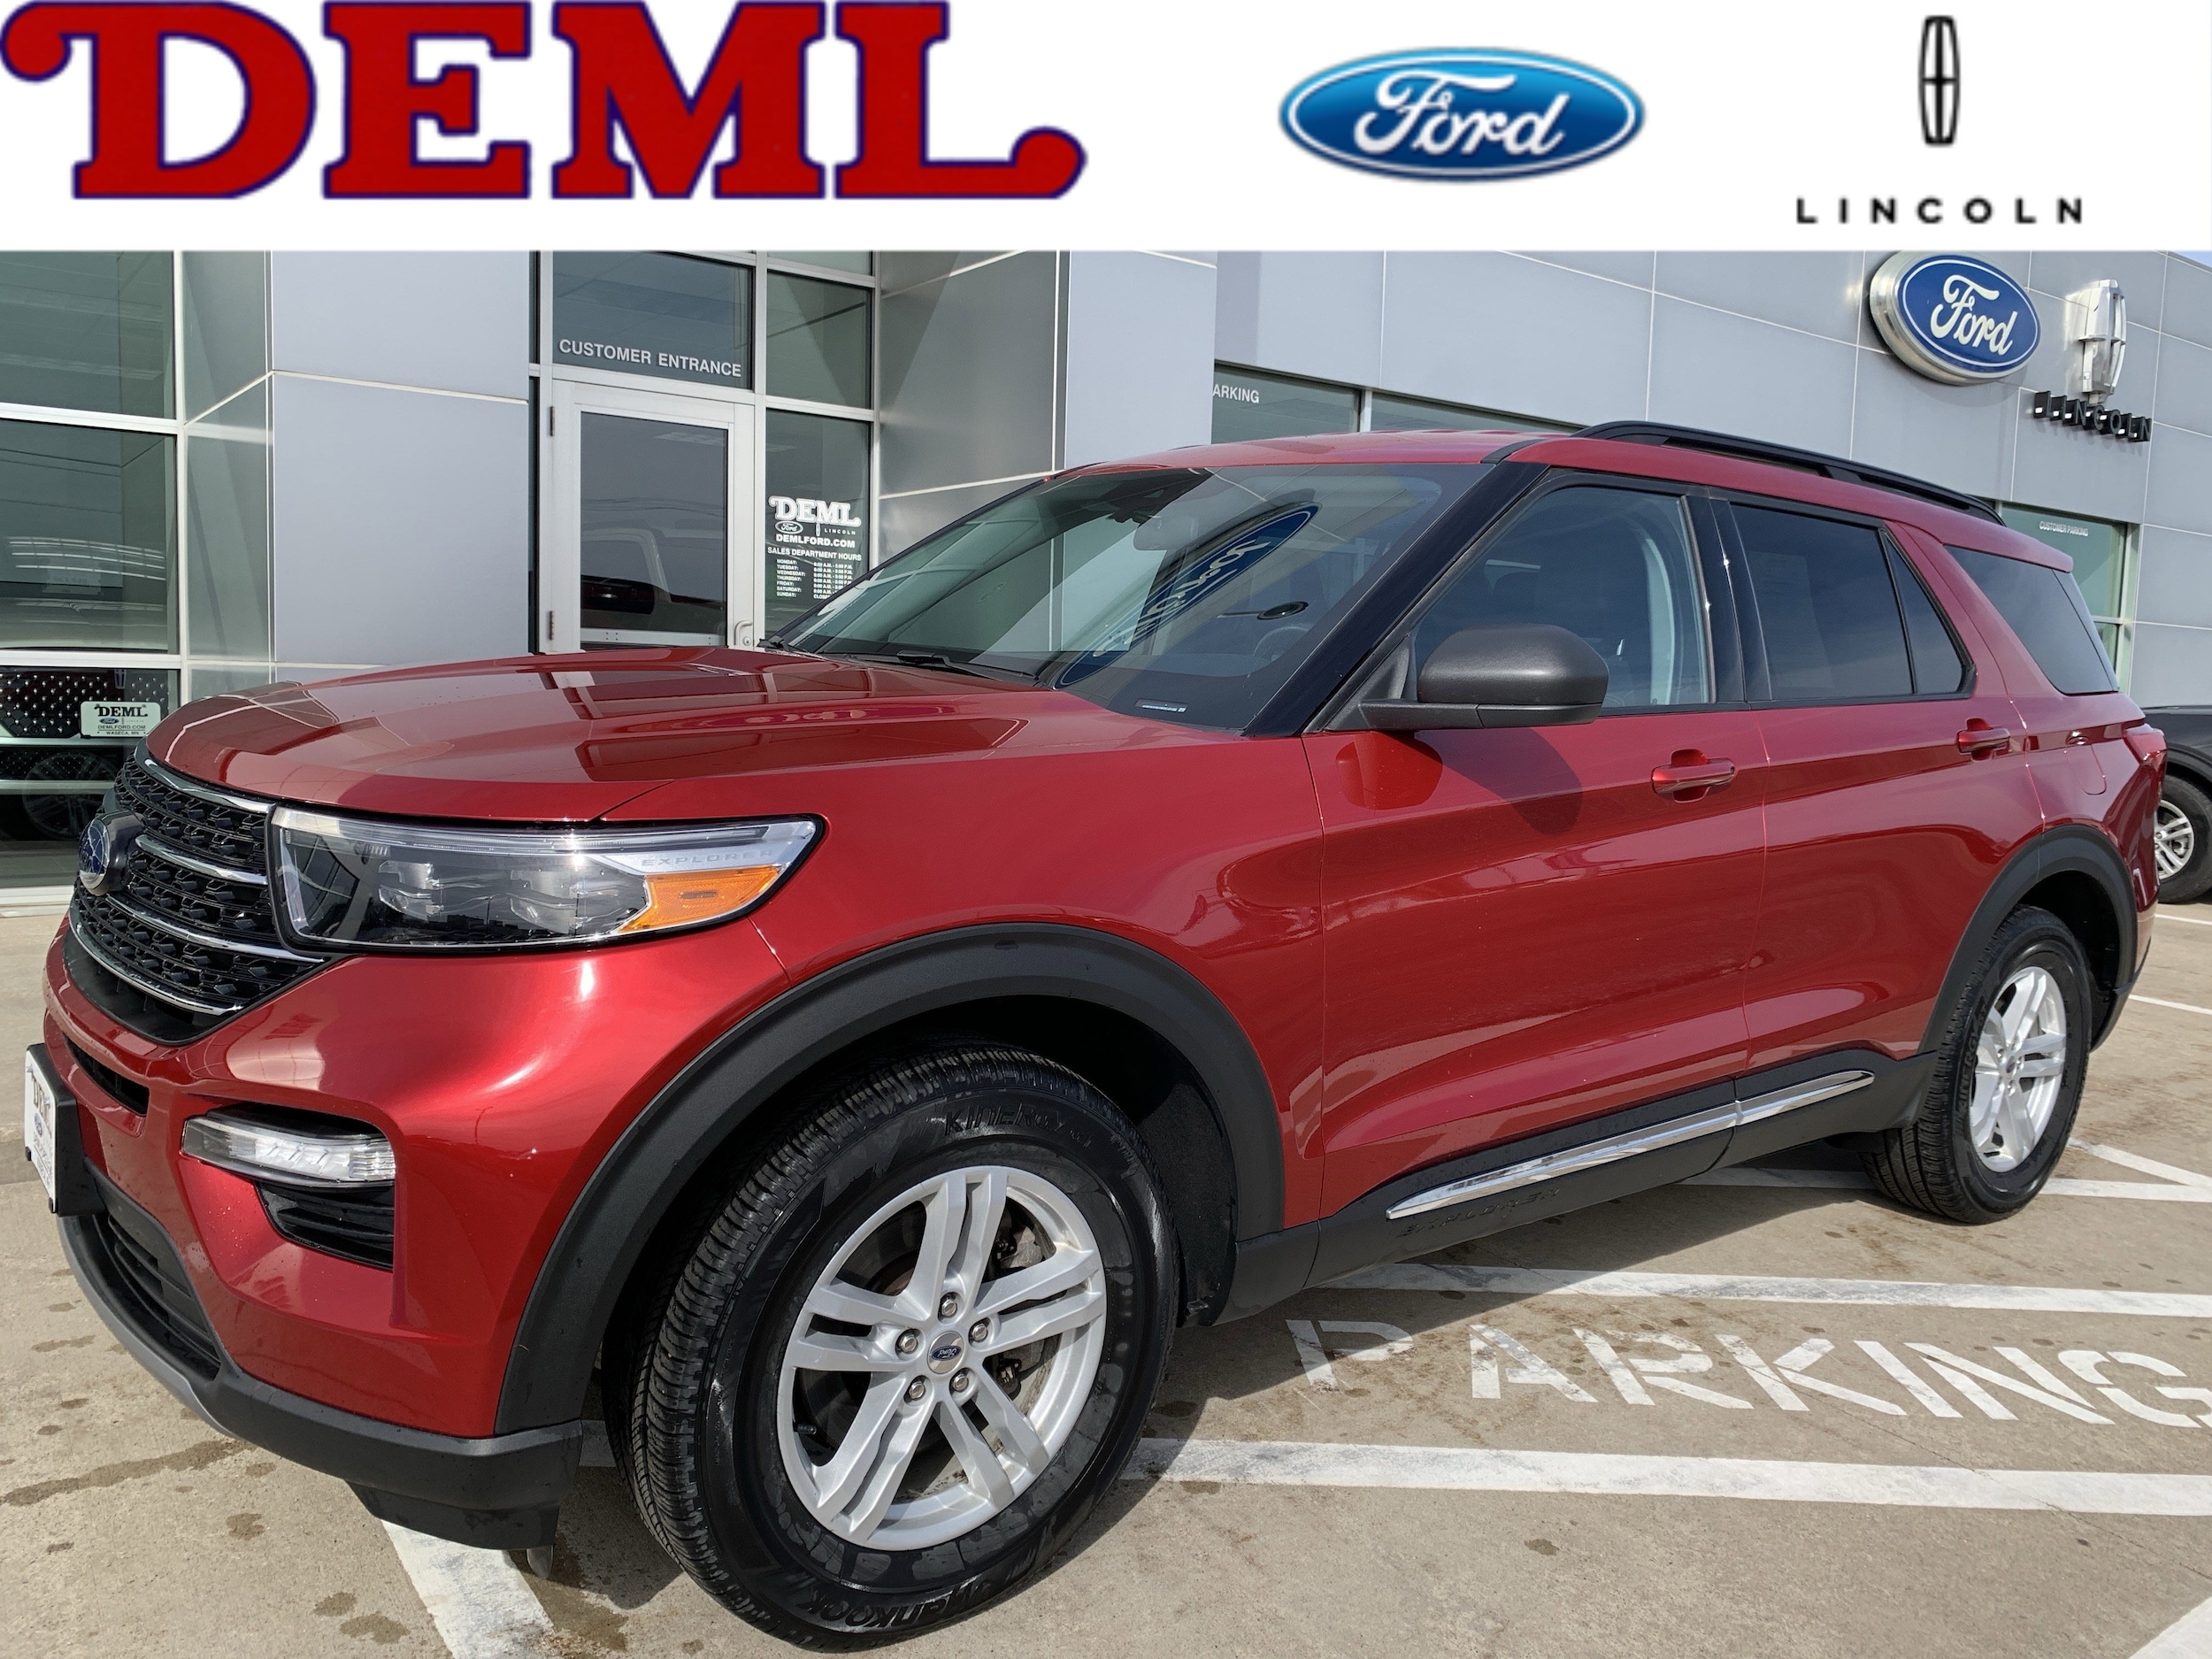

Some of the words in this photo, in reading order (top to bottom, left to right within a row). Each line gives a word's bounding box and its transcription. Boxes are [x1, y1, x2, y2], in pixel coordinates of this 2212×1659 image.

[1930, 274, 2018, 355] Ford
[558, 338, 651, 365] CUSTOMER
[658, 352, 741, 378] ENTRANCE
[1212, 383, 1260, 404] ARKING
[2034, 391, 2153, 442] LINCOLN
[768, 495, 862, 527] DEML
[2039, 520, 2067, 533] CUSTOMER
[776, 534, 856, 549] DEMLFORD.COM
[767, 547, 790, 556] SALES
[792, 549, 837, 559] DEPARTMENT
[94, 706, 149, 717] DEML
[641, 850, 773, 866] EXPLORER
[1285, 1319, 2212, 1428] PARKING
